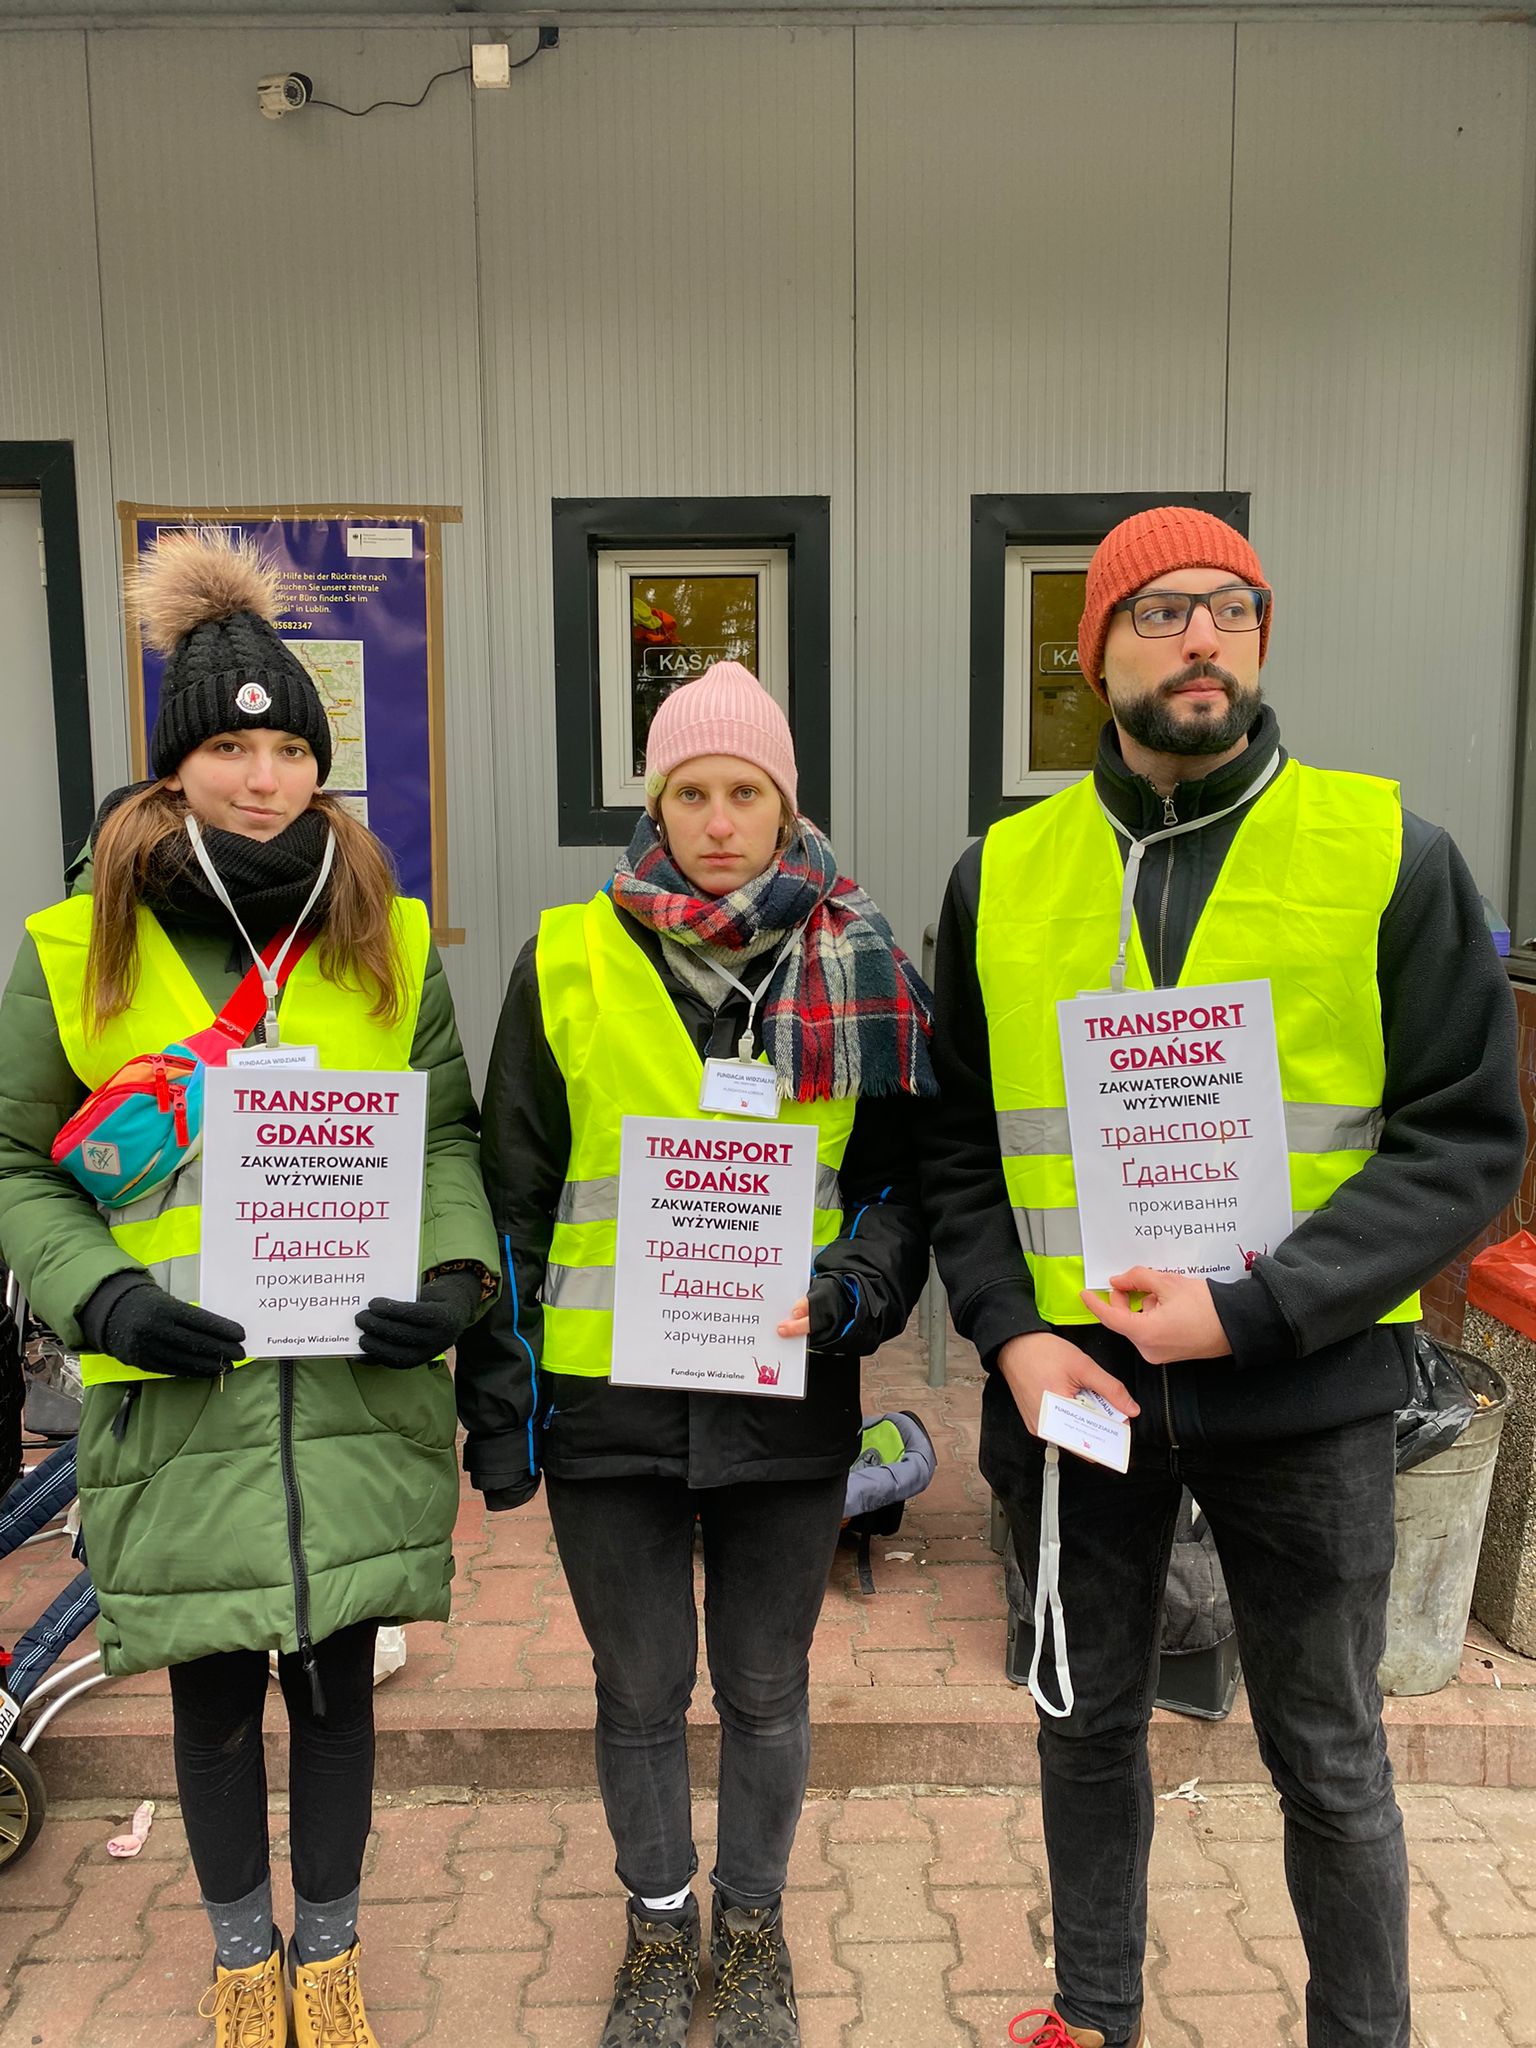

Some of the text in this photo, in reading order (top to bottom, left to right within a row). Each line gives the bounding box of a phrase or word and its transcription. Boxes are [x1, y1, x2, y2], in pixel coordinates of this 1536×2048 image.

[283, 572, 302, 580] Hilfe
[304, 572, 316, 580] bei
[317, 572, 330, 580] der
[331, 572, 366, 581] Rückreise
[368, 573, 388, 582] nach
[308, 583, 320, 591] Sie
[322, 584, 346, 592] unsere
[348, 584, 380, 592] zentrale
[299, 593, 318, 602] Büro
[319, 593, 343, 602] finden
[344, 594, 356, 602] Sie
[296, 604, 304, 612] in
[305, 604, 331, 613] Lublin.
[1054, 650, 1079, 666] KA
[1084, 1004, 1245, 1039] TRANSPORT
[272, 1056, 306, 1064] WIDZIALNE
[1110, 1037, 1226, 1070] GDAŃSK
[716, 1072, 745, 1081] FUNDACJA
[746, 1076, 775, 1084] WIDZIALNE
[1099, 1072, 1243, 1094] ZAKWATEROWANIE
[234, 1089, 400, 1113] TRANSPORT
[1124, 1092, 1220, 1111] WYŻYWIENIE
[256, 1118, 374, 1146] GDAŃSK
[1100, 1119, 1252, 1150] транспорт
[646, 1136, 794, 1164] TRANSPORT
[240, 1156, 388, 1168] ZAKWATEROWANIE
[265, 1172, 364, 1186] WYŻYWIENIE
[666, 1166, 770, 1194] GDAŃSK
[1122, 1158, 1239, 1188] Ґданськ
[236, 1201, 390, 1224] транспорт
[651, 1198, 782, 1216] ZAKWATEROWANIE
[1128, 1196, 1238, 1216] проживання
[672, 1214, 760, 1232] WYŻYWIENIE
[1134, 1221, 1236, 1240] харчування
[255, 1233, 370, 1262] Ґданськ
[646, 1240, 783, 1268] транспорт
[1187, 1264, 1231, 1274] Widzialne
[256, 1271, 365, 1288] проживання
[661, 1270, 764, 1299] Ґданськ
[258, 1294, 360, 1311] харчування
[662, 1308, 760, 1324] проживання
[267, 1334, 350, 1346] Fundacja Widzialne
[664, 1330, 756, 1346] харчування
[671, 1368, 745, 1380] Fundacja Widzialne
[1054, 1405, 1086, 1422] FUNDACJA
[1086, 1418, 1120, 1437] WIDZIALNE
